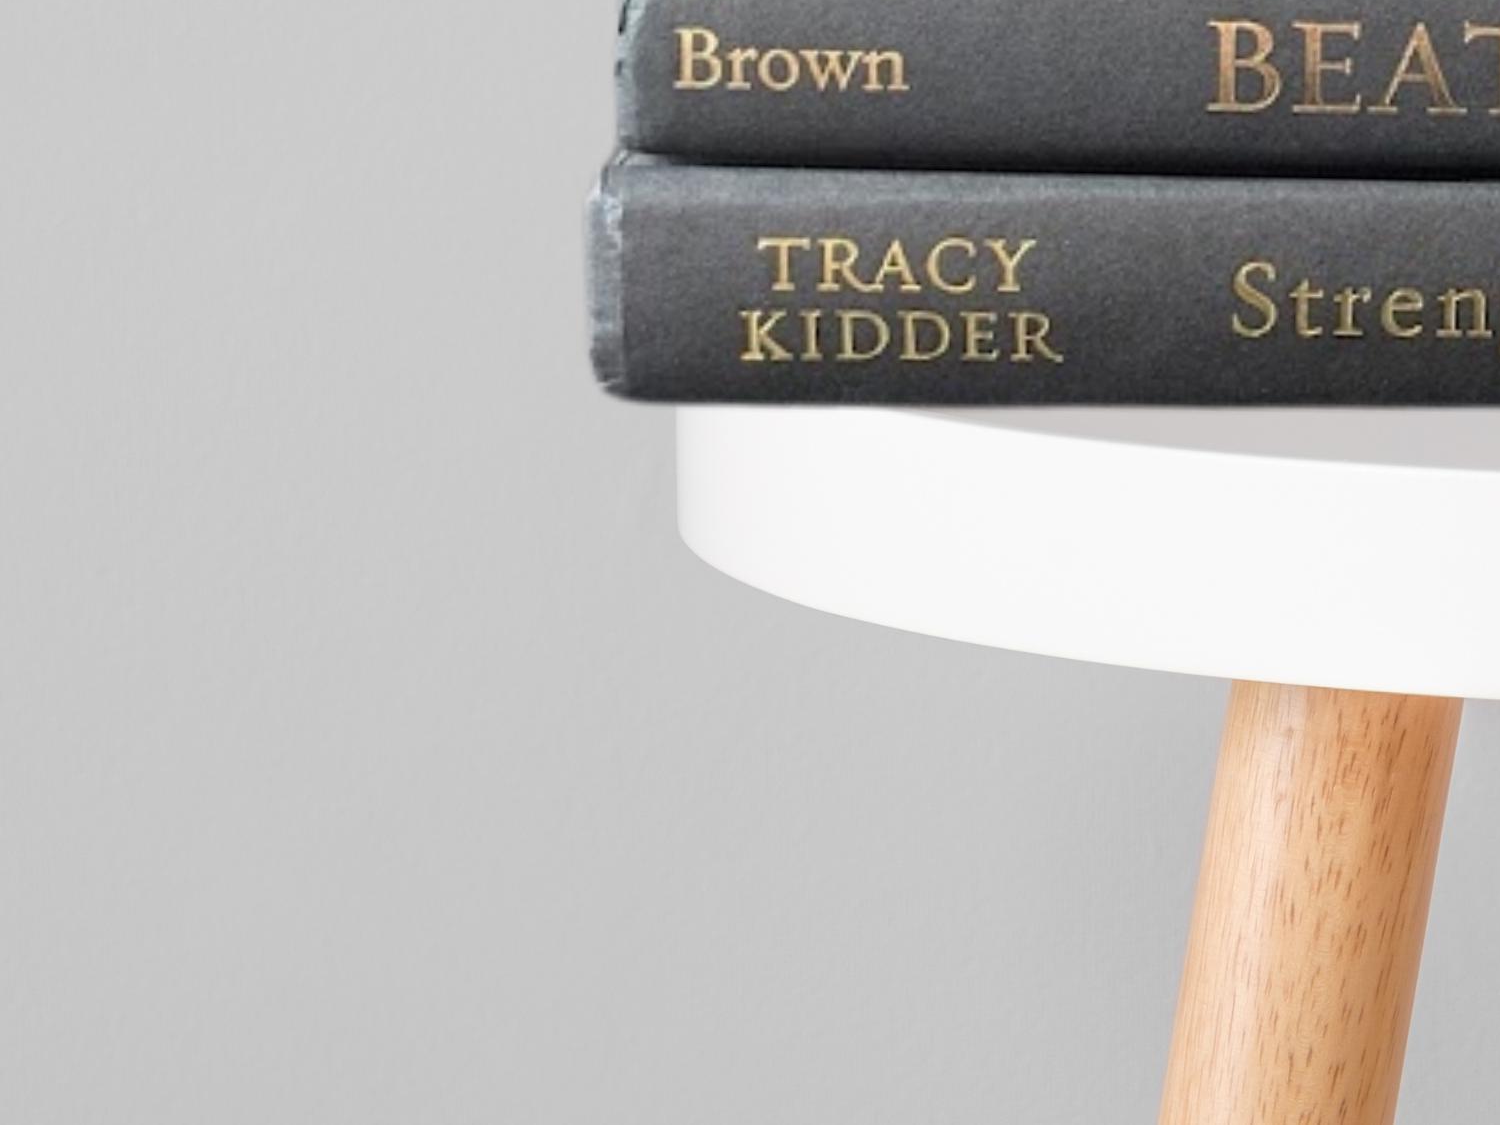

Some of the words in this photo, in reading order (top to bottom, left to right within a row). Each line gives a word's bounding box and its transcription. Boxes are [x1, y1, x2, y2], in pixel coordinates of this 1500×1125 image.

[673, 27, 910, 92] Brown
[756, 237, 1037, 293] TRACY
[740, 310, 1064, 363] KIDDER
